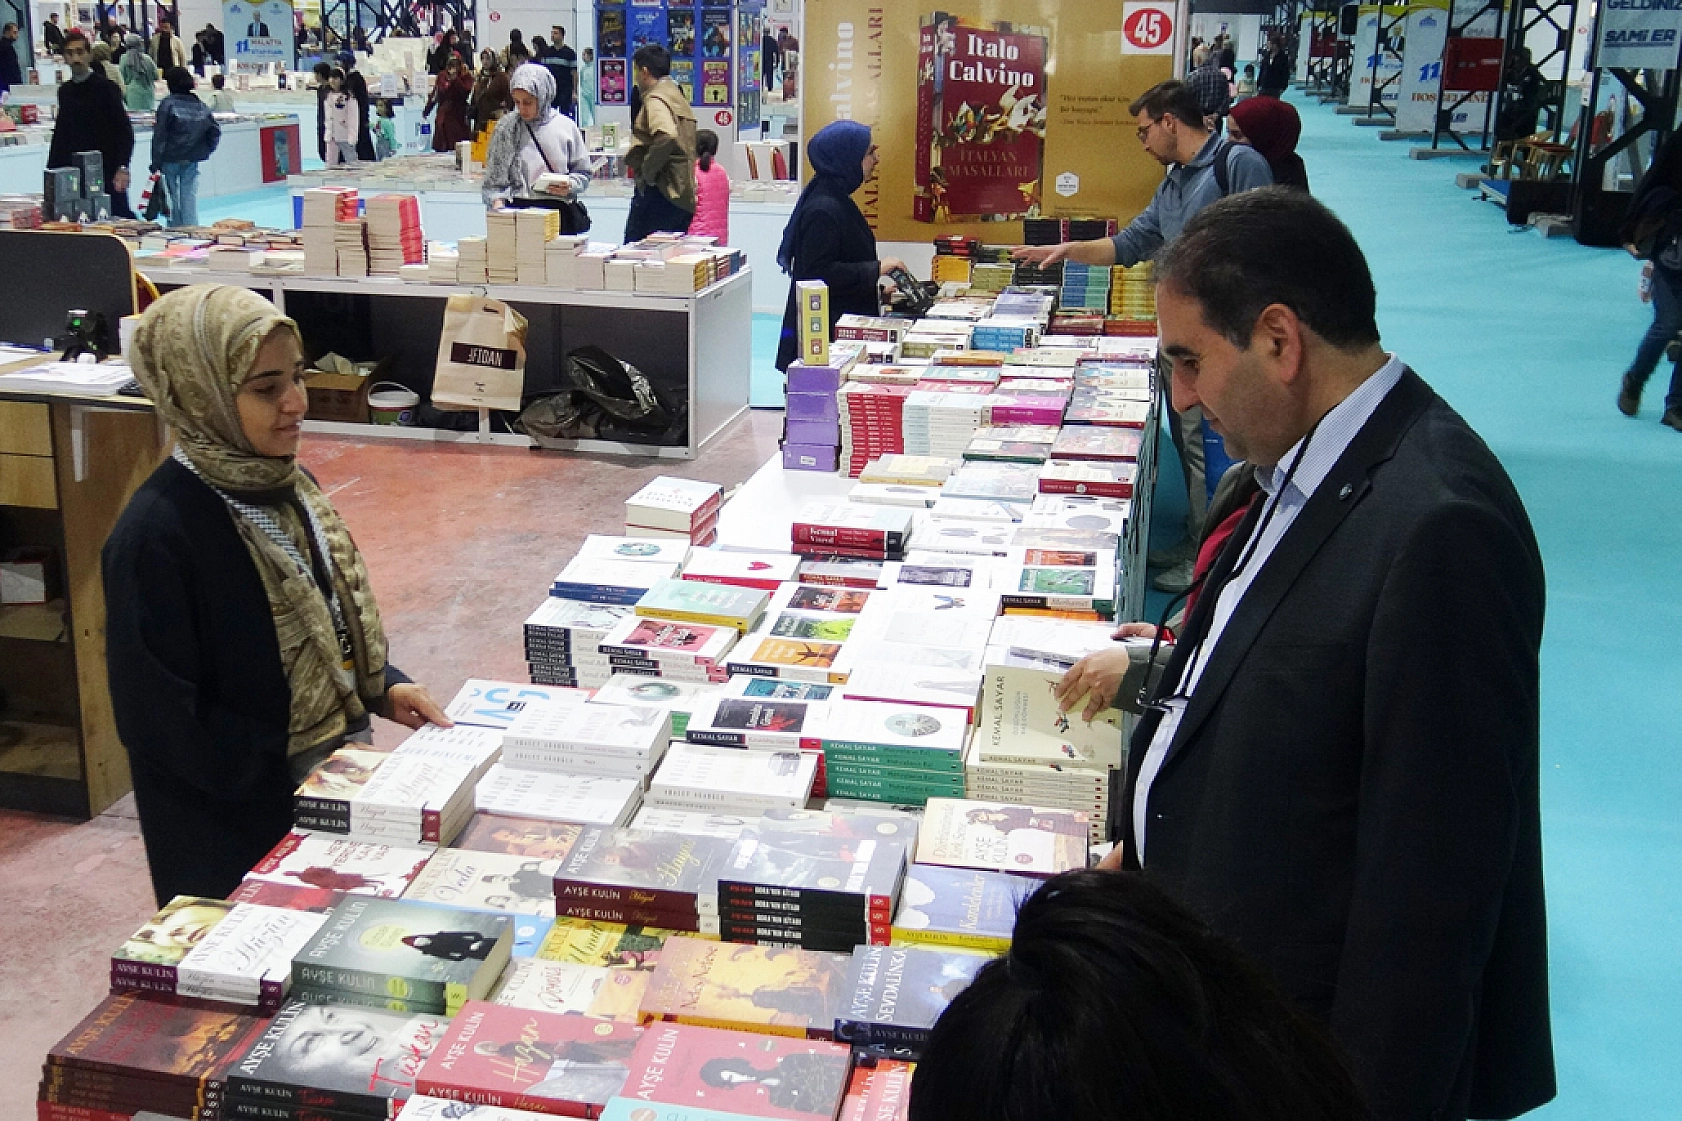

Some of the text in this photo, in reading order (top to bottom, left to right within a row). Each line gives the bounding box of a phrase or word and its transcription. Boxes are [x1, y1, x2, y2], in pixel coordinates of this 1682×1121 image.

[1134, 17, 1162, 44] 45
[1651, 29, 1677, 41] ER
[967, 33, 1019, 61] Italo
[829, 21, 854, 121] alvino
[949, 59, 1035, 88] Calvino
[959, 147, 1018, 163] İTALYAN
[947, 164, 1029, 178] MASALLARI
[992, 675, 1005, 746] KEMAL SAYAR
[974, 836, 992, 862] AYŞE
[992, 836, 1009, 864] KULİN
[564, 886, 589, 897] AYŞE
[591, 886, 621, 900] KULİN
[566, 906, 624, 921] AYŞE KULİN
[308, 900, 369, 959] AYŞE KULİN
[301, 967, 375, 991] AYŞE KULİN
[851, 946, 883, 1019] AYŞE KULİN
[239, 999, 306, 1075] AYŞE KULİN
[440, 1010, 486, 1070] AYŞE KULİN
[368, 1019, 441, 1092] Türkan
[636, 1028, 680, 1101] AYŞE KULİN
[239, 1083, 262, 1095] AYŞE
[264, 1087, 292, 1098] KULİN
[427, 1087, 460, 1099] AYŞE
[463, 1091, 502, 1106] KULİN
[881, 1063, 907, 1103] KULİN
[236, 1104, 260, 1115] AYŞE
[261, 1107, 289, 1118] KULİN
